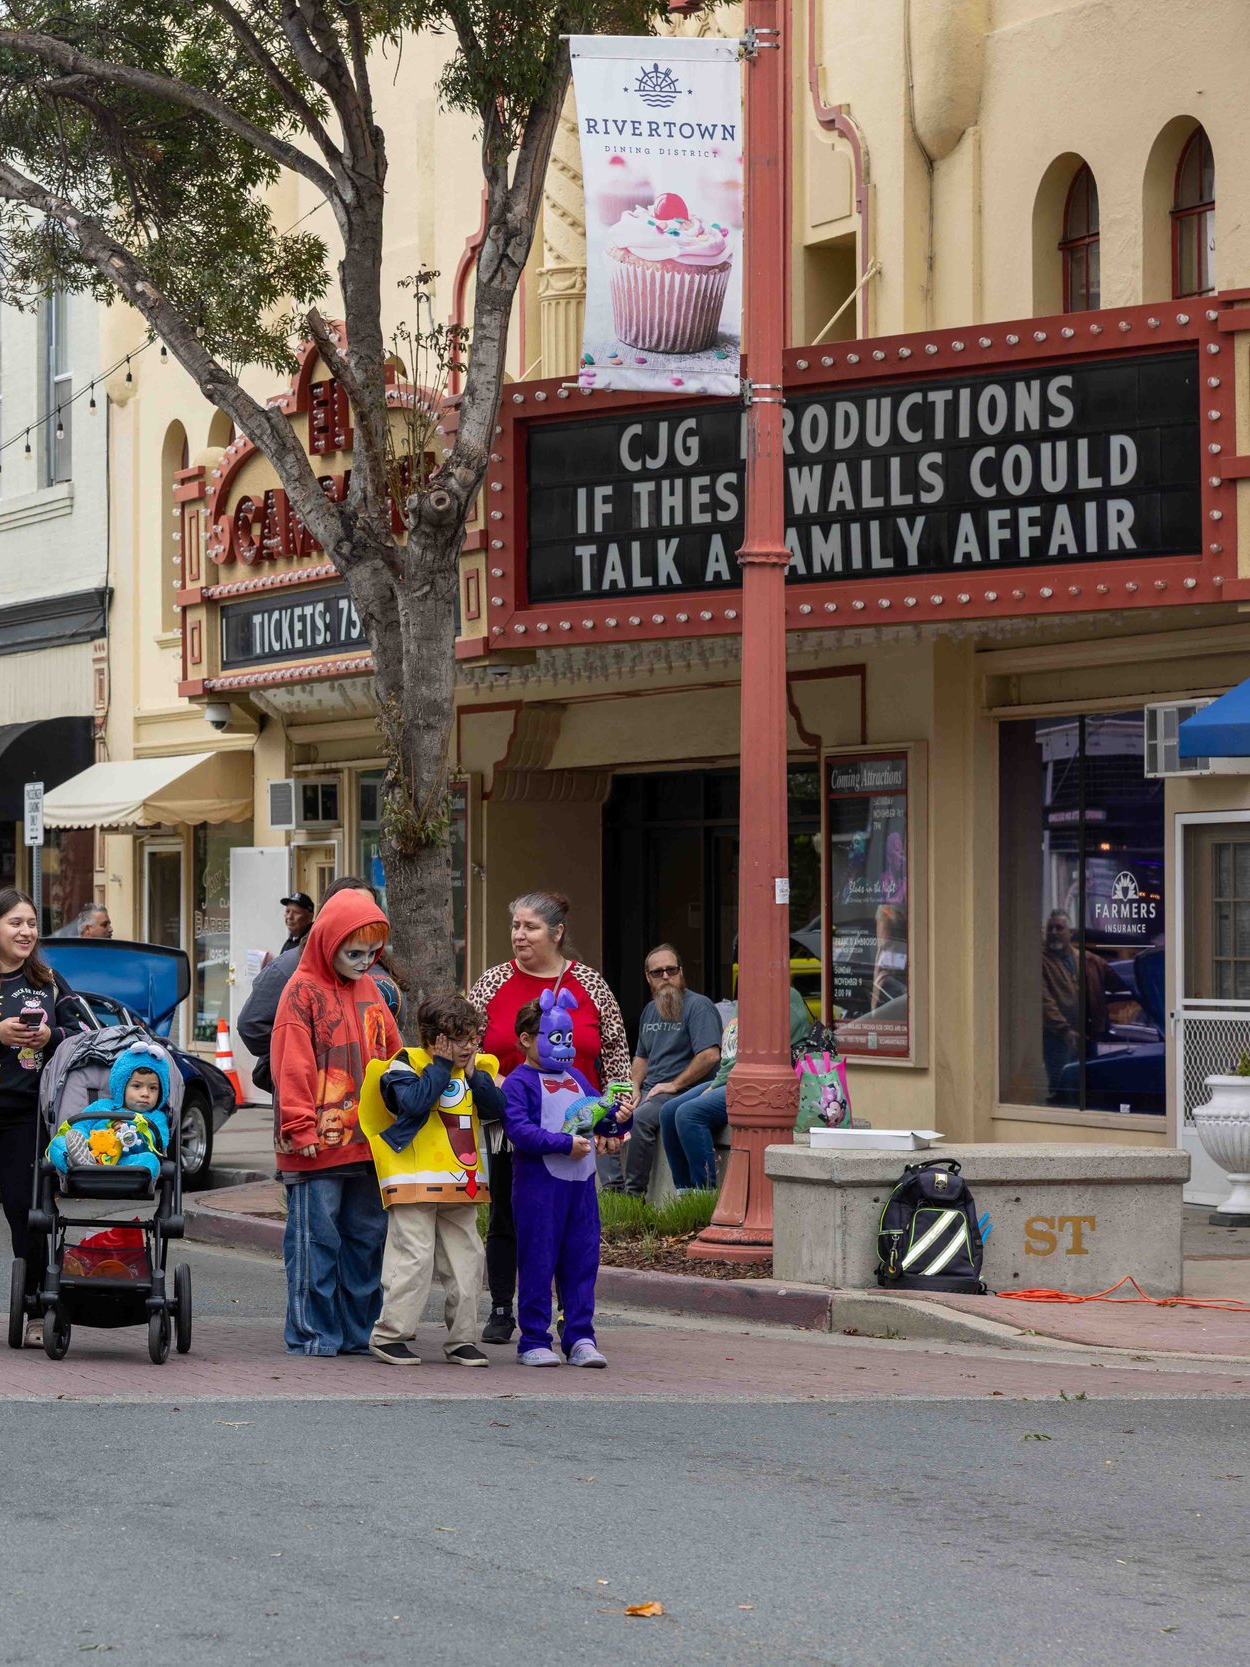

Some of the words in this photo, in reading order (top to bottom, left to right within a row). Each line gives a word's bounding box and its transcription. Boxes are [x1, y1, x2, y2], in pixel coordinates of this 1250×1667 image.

[585, 118, 736, 141] RIVERTOWN
[604, 145, 651, 155] DINING
[659, 148, 719, 158] DISTRICT
[307, 377, 355, 456] EL
[619, 417, 700, 472] CJG
[739, 375, 1074, 460] RODUCTIONS
[577, 485, 614, 534] IF
[633, 471, 741, 529] THES
[788, 451, 945, 515] WALLS
[969, 434, 1138, 498] COULD
[574, 537, 682, 591] TALK
[704, 533, 731, 582] A
[784, 515, 926, 577] AMILY
[953, 498, 1138, 563] AFFAIR
[252, 600, 331, 654] TICKETS:
[338, 598, 366, 641] 75
[831, 768, 861, 792] Coming
[861, 766, 903, 787] Attractions
[849, 880, 864, 894] Blues
[195, 910, 230, 939] BARBE
[1095, 903, 1156, 919] FARMERS
[1104, 924, 1146, 933] INSURANCE
[834, 978, 857, 986] NOVEMBER
[1024, 1215, 1096, 1257] ST
